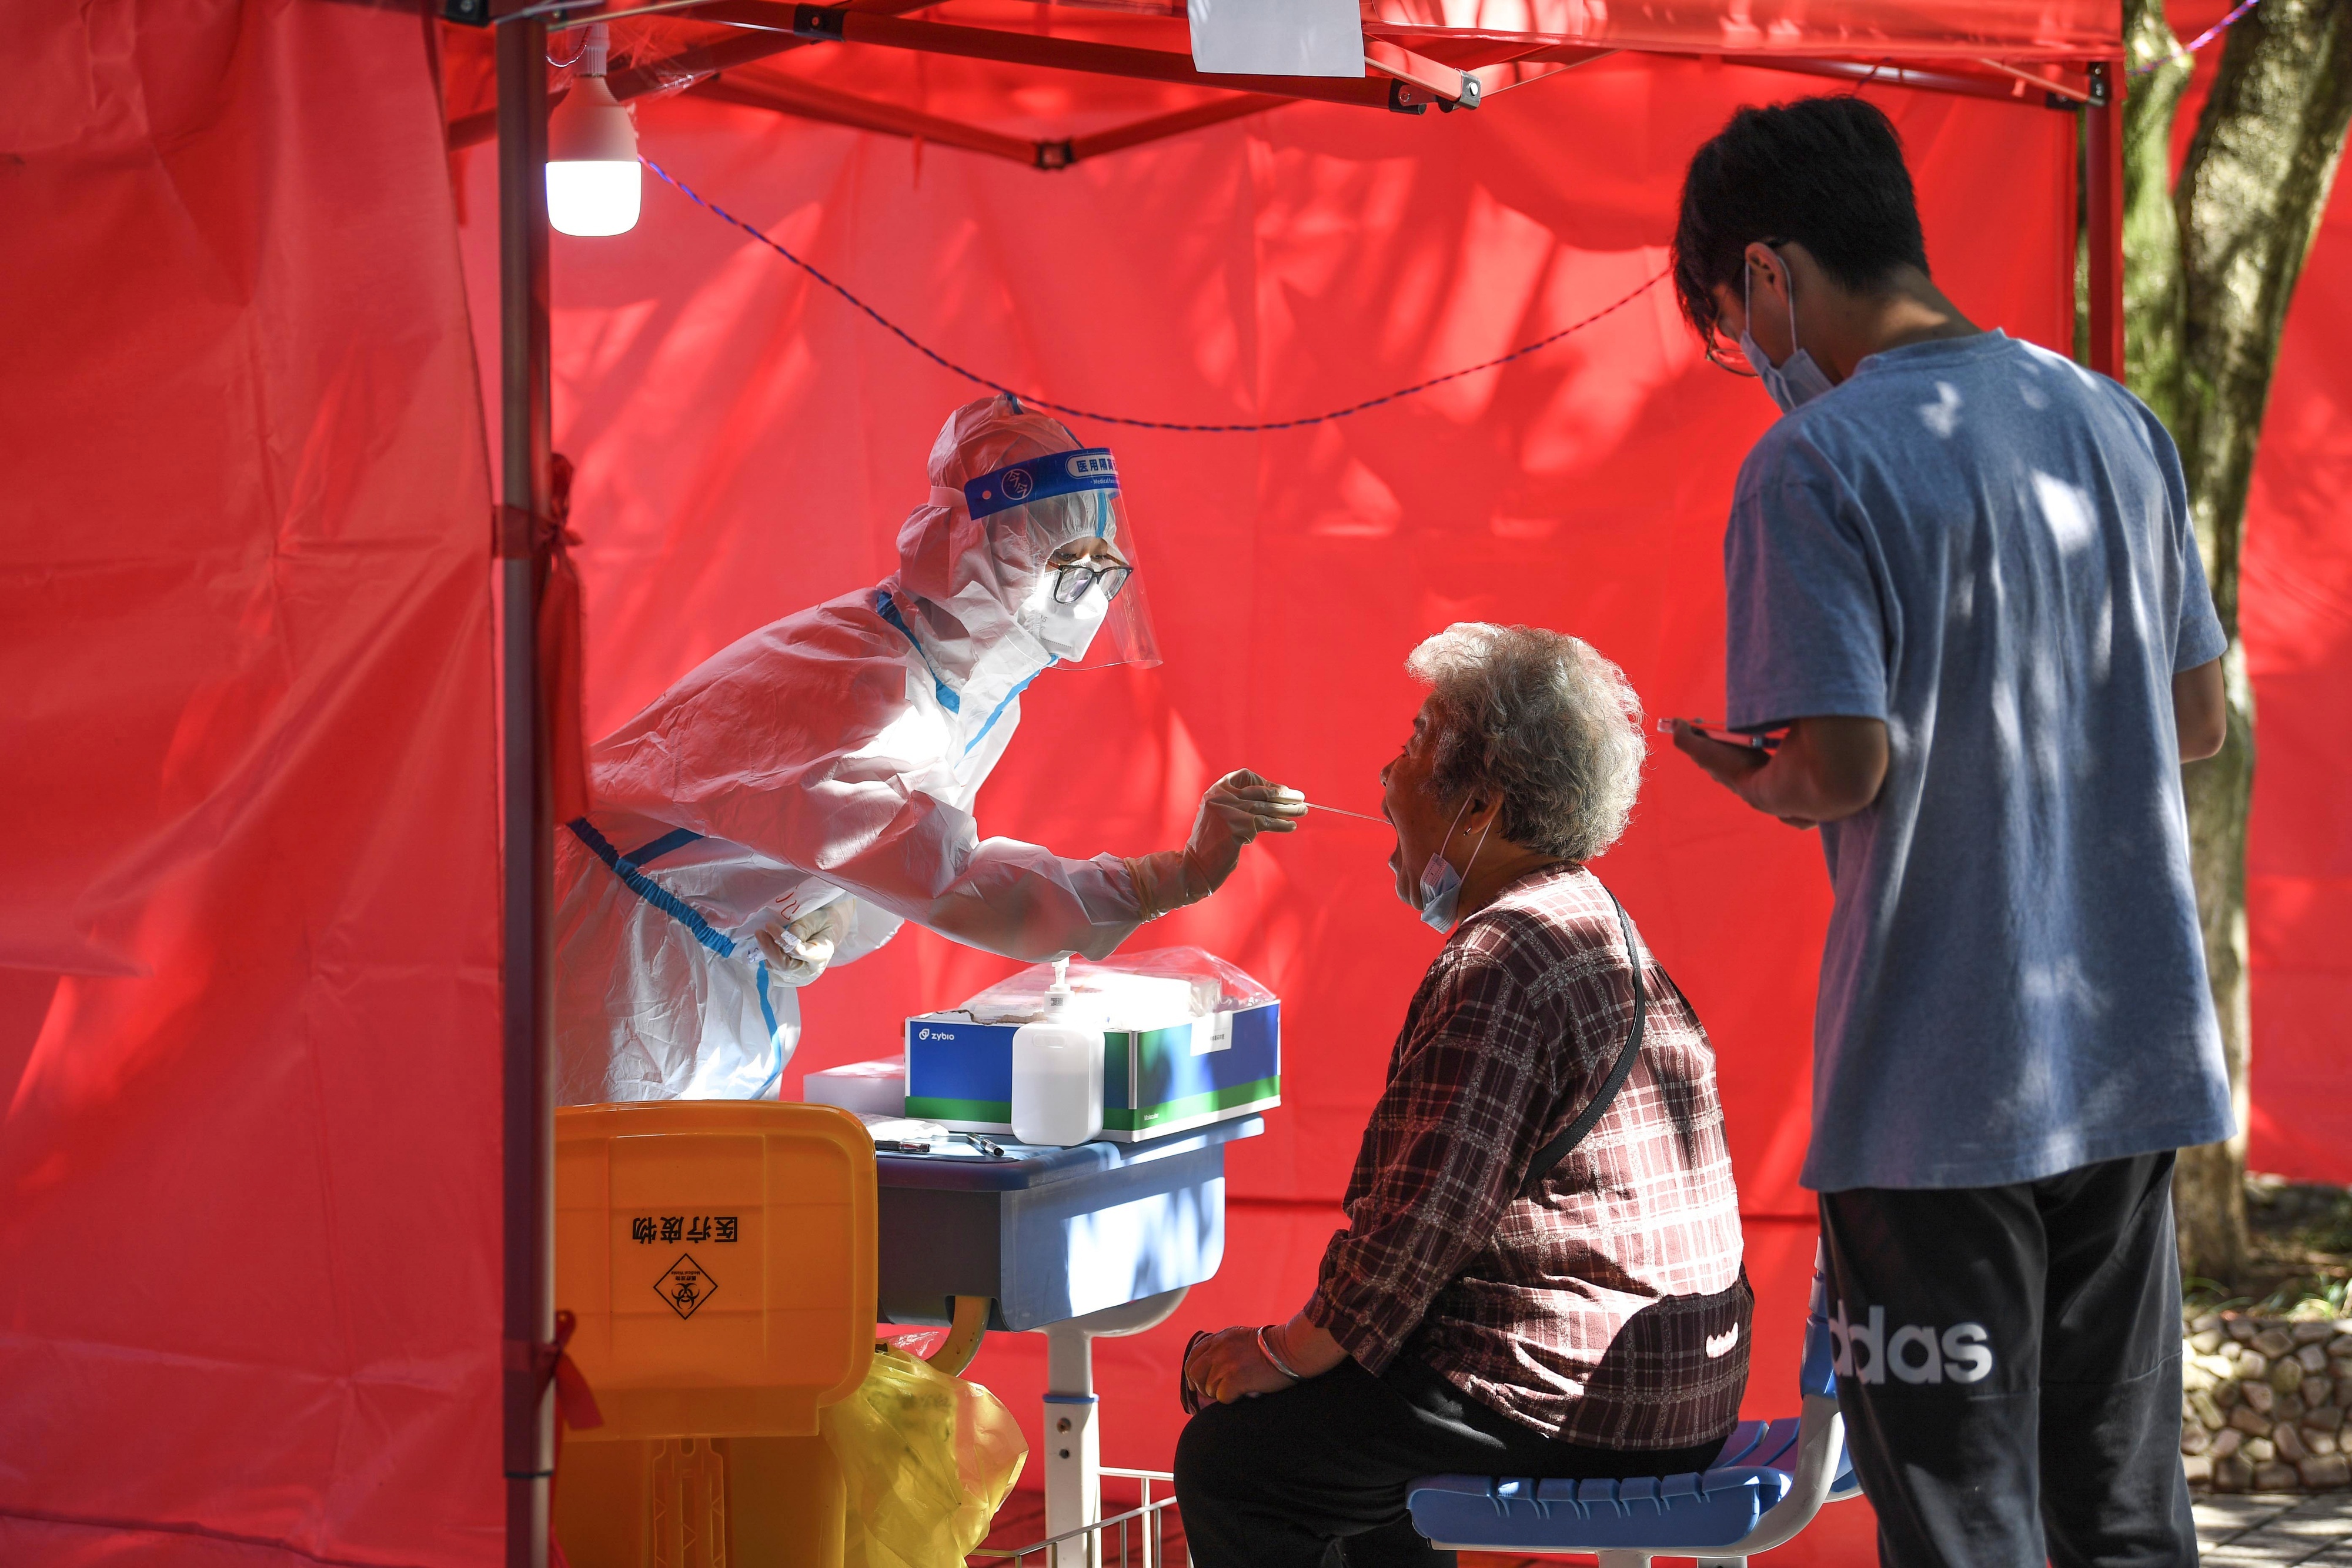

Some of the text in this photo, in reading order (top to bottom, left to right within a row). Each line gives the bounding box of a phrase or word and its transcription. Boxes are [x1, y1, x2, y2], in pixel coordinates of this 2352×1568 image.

[931, 1032, 955, 1041] zybio
[632, 1216, 738, 1245] 医疗废物
